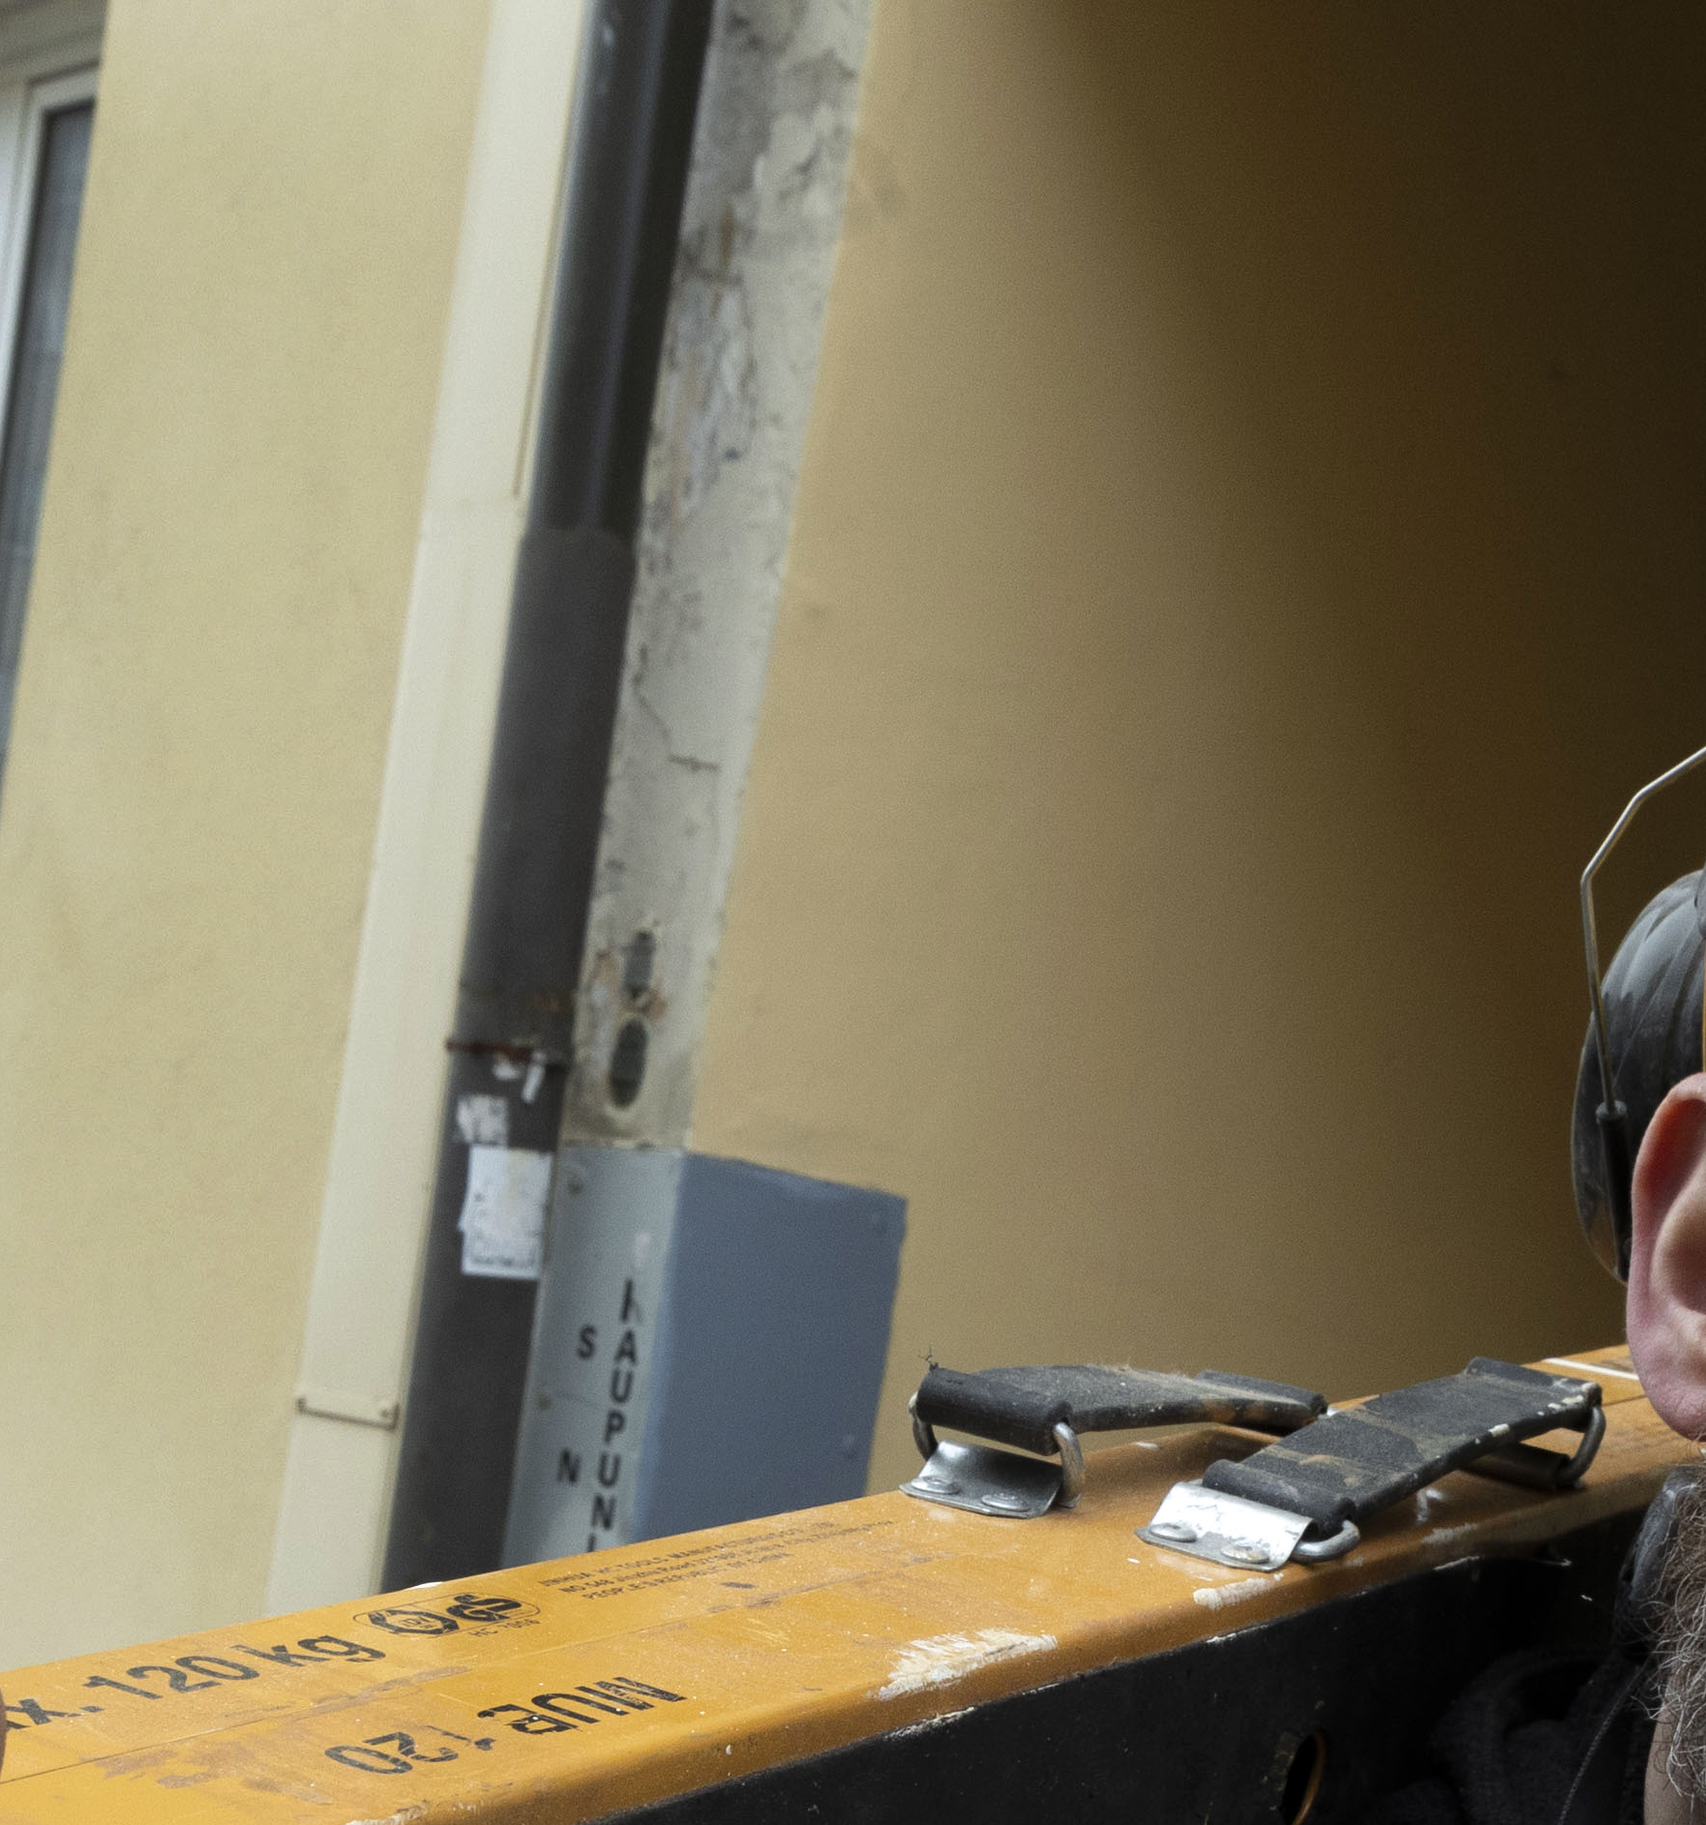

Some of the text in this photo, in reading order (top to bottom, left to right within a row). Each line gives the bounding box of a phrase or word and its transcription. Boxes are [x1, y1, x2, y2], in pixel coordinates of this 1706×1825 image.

[82, 1654, 262, 1700] 120
[231, 1634, 387, 1667] kg
[323, 1726, 496, 1775] 120
